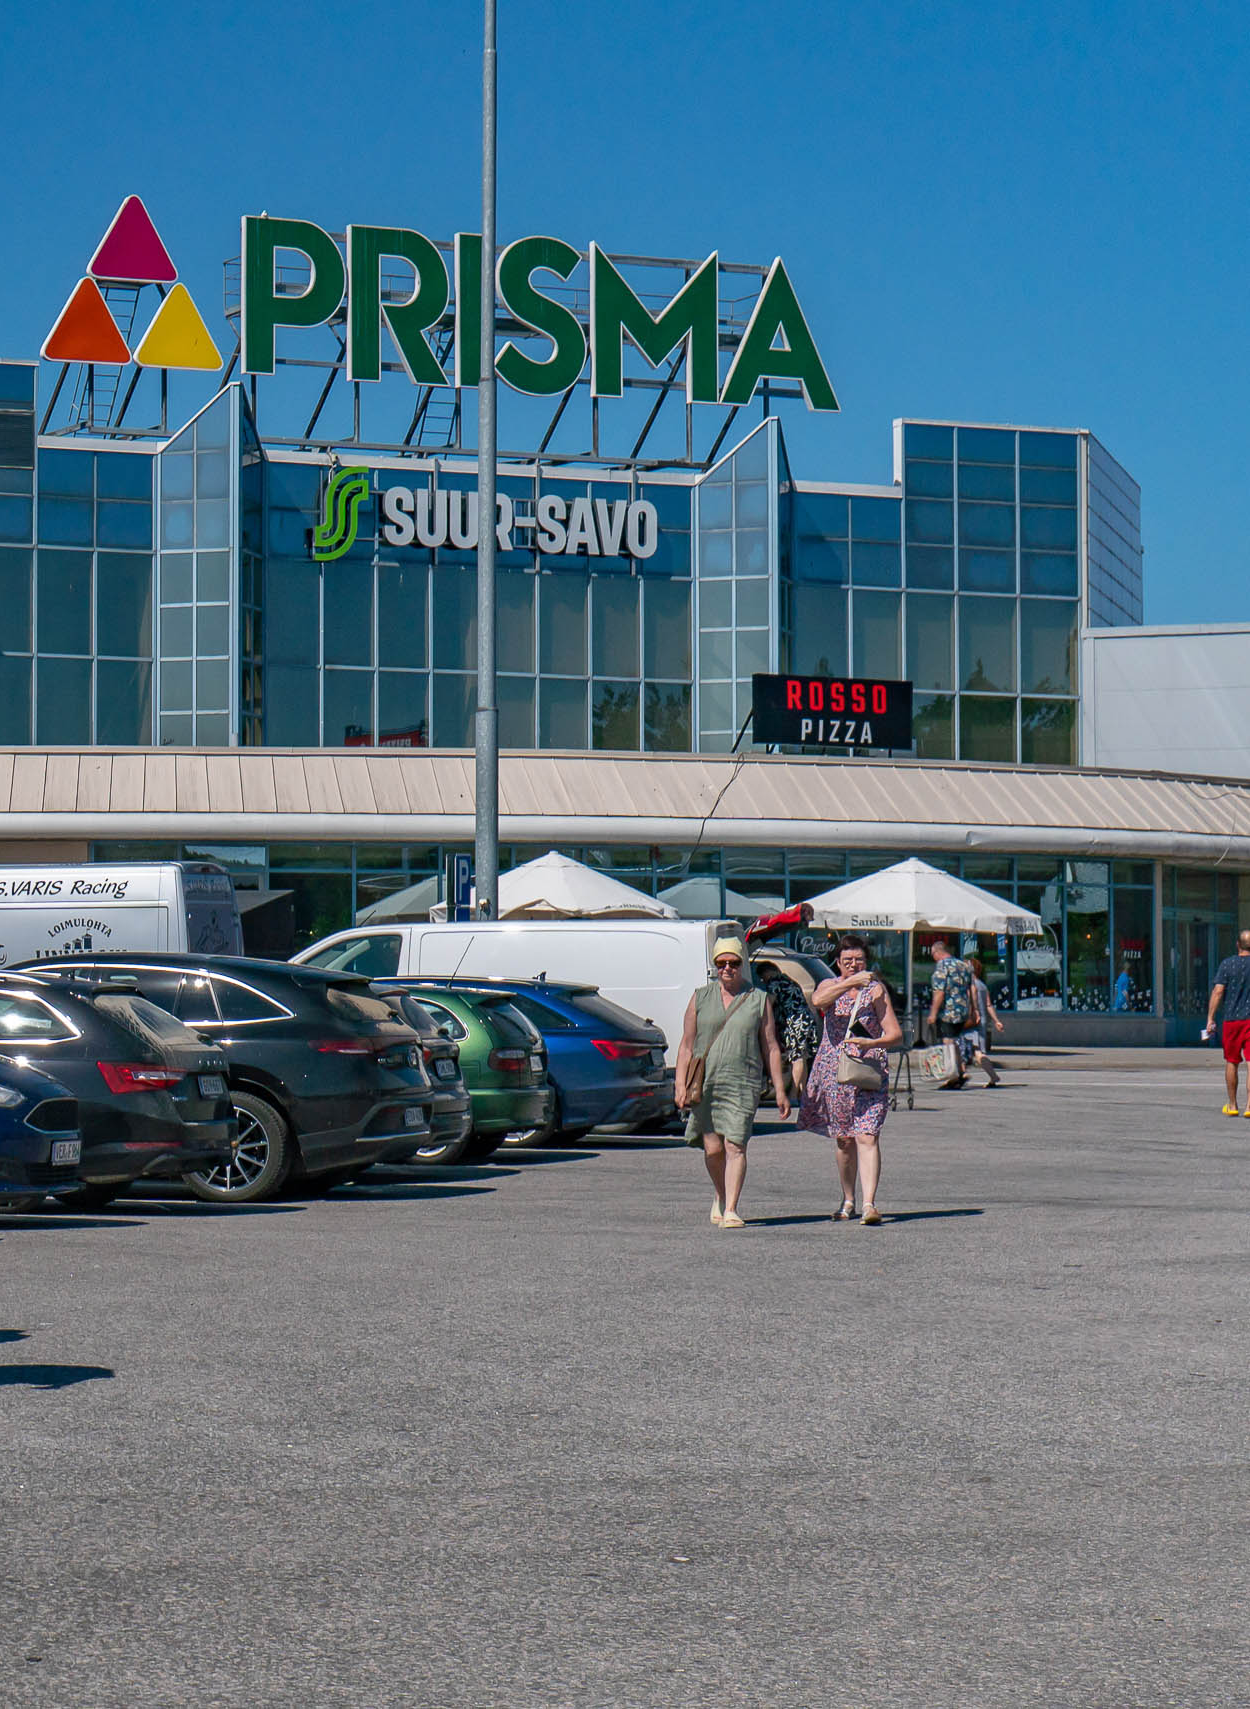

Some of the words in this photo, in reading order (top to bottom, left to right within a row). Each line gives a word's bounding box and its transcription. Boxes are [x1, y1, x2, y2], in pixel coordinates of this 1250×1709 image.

[240, 214, 841, 413] PRISMA
[382, 486, 658, 560] SUUR-SAVO
[786, 680, 888, 714] ROSSO
[801, 718, 873, 744] PIZZA
[70, 878, 129, 899] Racing
[459, 860, 469, 901] P
[47, 917, 113, 939] LOIMULOHTA
[851, 914, 894, 927] Sandels
